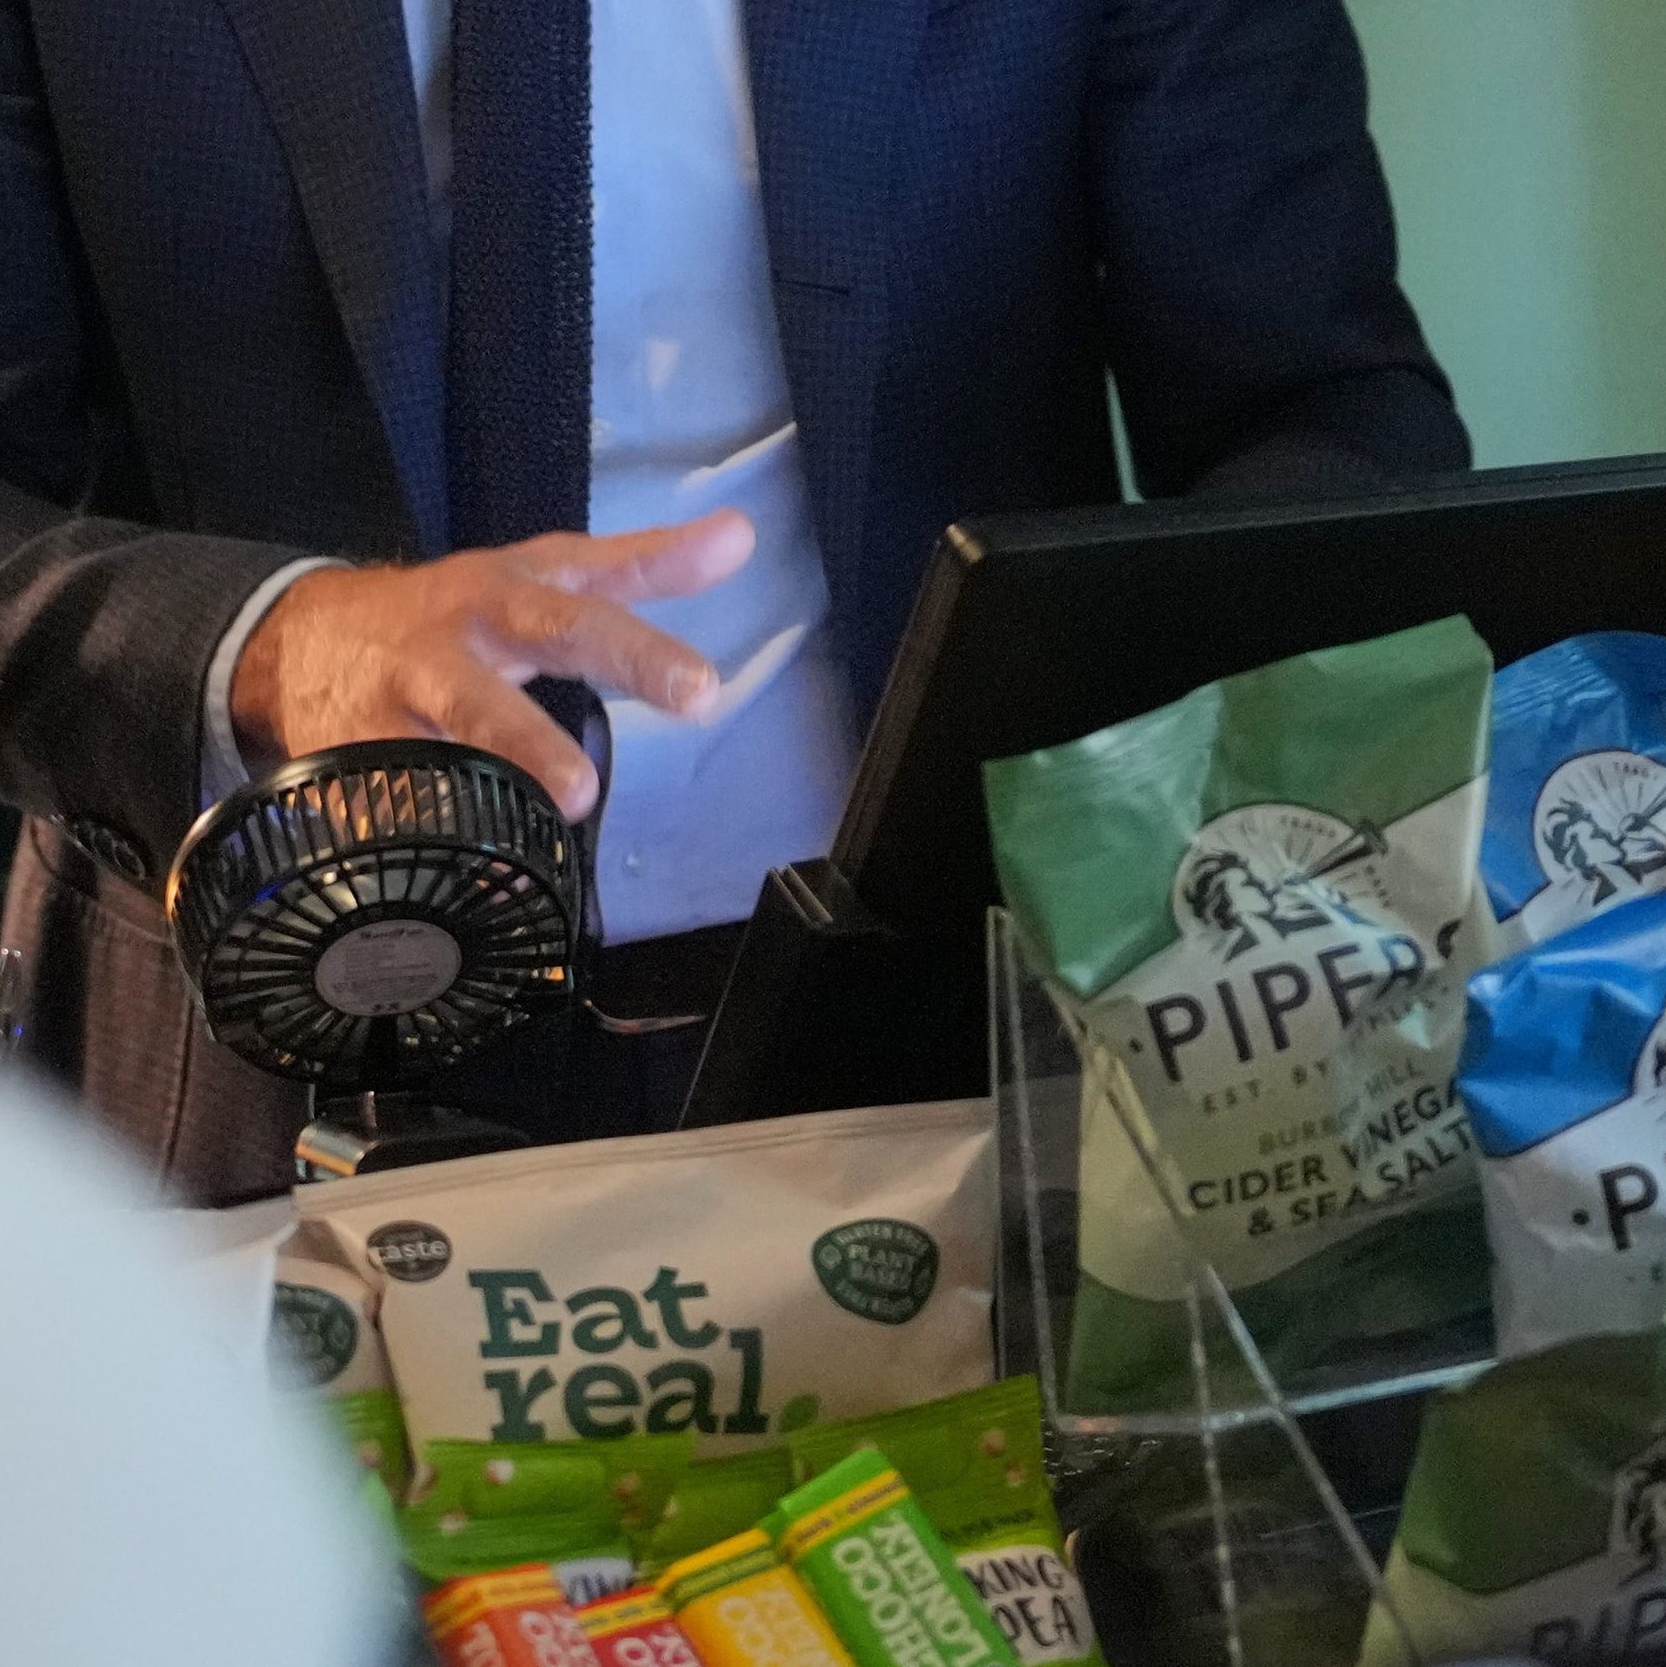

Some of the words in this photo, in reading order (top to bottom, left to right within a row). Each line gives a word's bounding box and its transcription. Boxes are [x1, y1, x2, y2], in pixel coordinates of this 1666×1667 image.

[1188, 1152, 1328, 1211] CIDER
[1247, 1205, 1276, 1236] &
[1375, 1112, 1473, 1194] SALT
[468, 1265, 721, 1359] Eat
[483, 1327, 771, 1444] real
